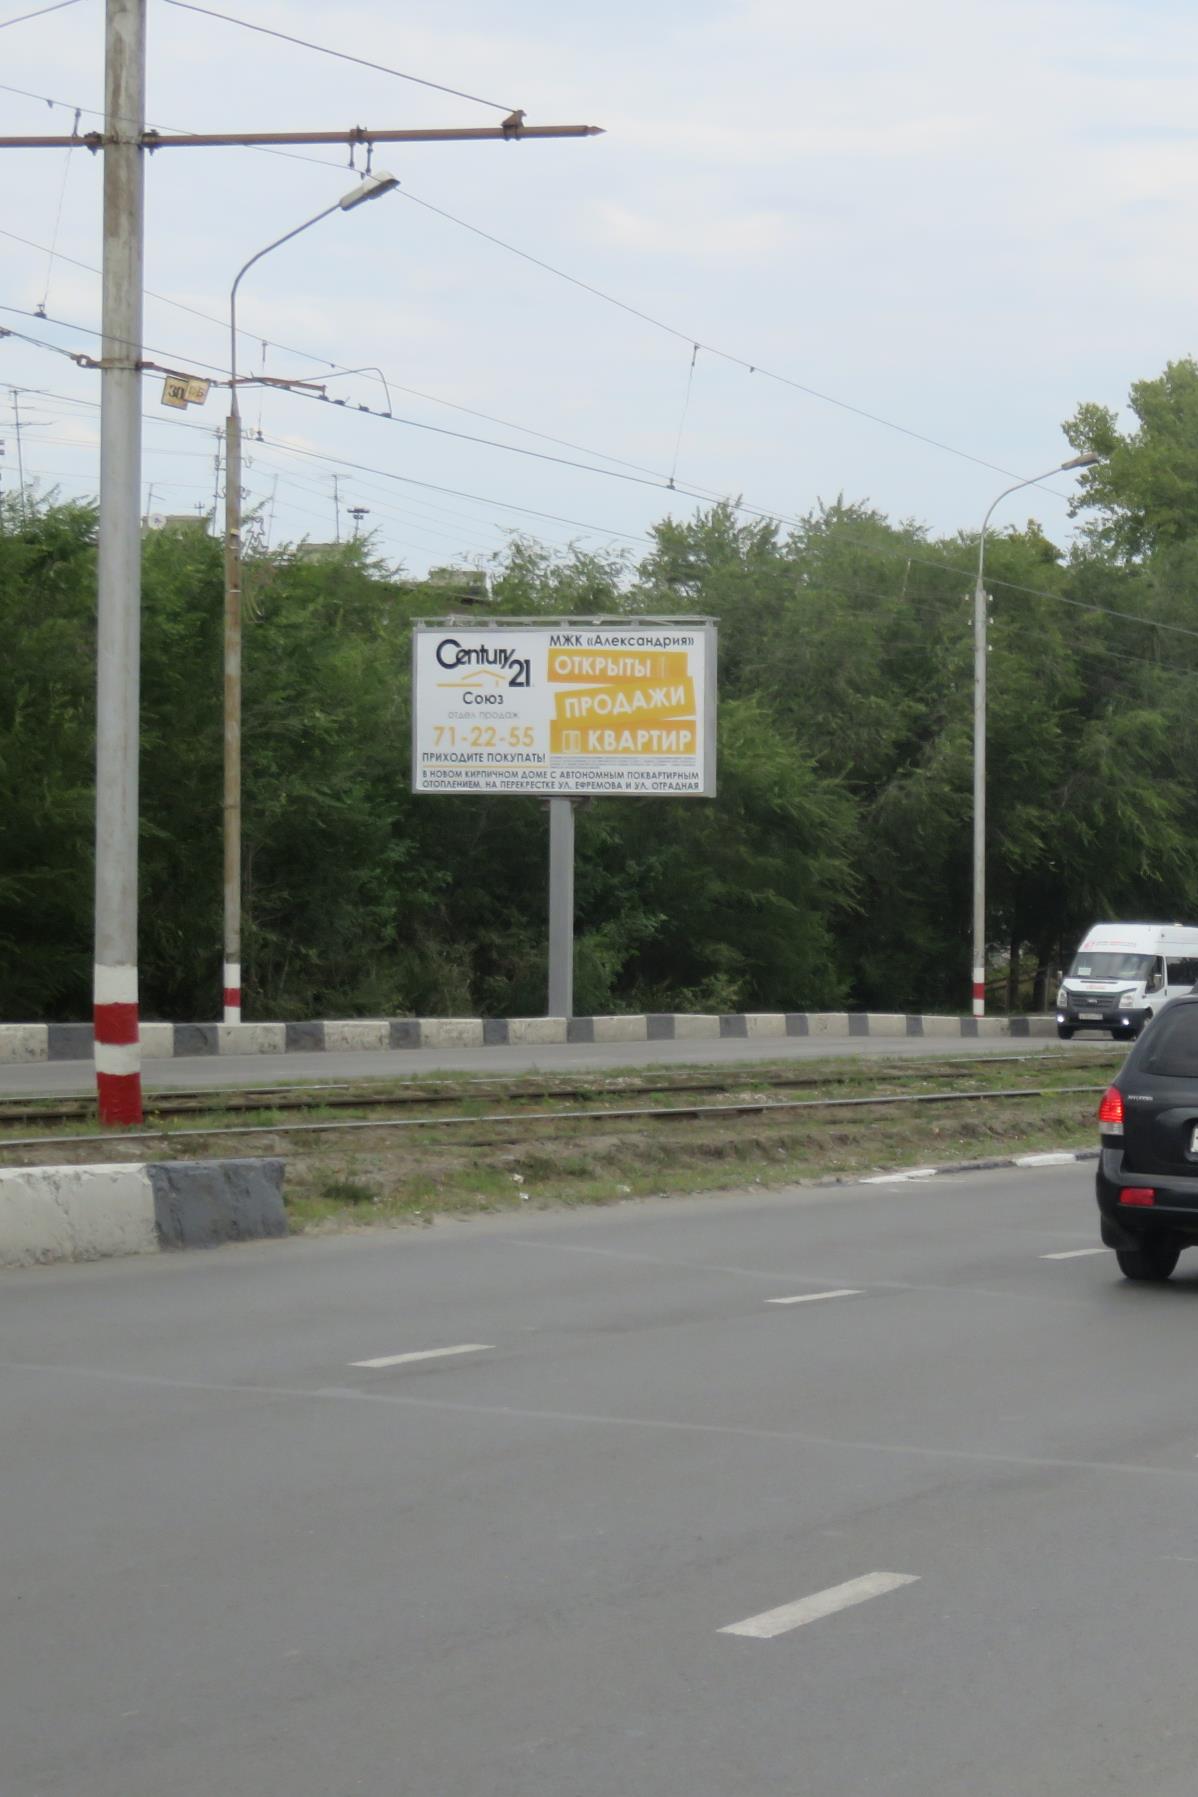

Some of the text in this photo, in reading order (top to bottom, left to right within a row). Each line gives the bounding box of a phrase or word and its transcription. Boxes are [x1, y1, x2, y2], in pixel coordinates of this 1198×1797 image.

[549, 634, 694, 649] МЖК «Александрия»
[436, 638, 516, 670] Century
[508, 659, 531, 688] 21
[554, 655, 652, 678] ОТКРЫТЫ
[462, 691, 504, 705] Союз
[564, 684, 685, 719] ПРОДАЖИ
[480, 711, 519, 720] продаж
[432, 725, 535, 748] 71-22-55
[587, 729, 692, 752] КВАРТИР
[422, 753, 483, 763] ПРИХОДИТЕ
[487, 753, 546, 763] ПОКУПАТЬ!
[422, 770, 428, 778] В
[430, 770, 463, 779] НОВОМ
[465, 771, 519, 779] КИРПИЧНОМ
[521, 771, 548, 780] ДОМЕ
[559, 771, 625, 780] АВТОНОМНЫМ
[627, 772, 699, 780] ПОКВАРТИРНЫМ
[485, 781, 498, 789] НА
[500, 781, 555, 789] ПЕРЕКРЕСТКЕ
[575, 782, 622, 790] ЕФРЕМОВА
[625, 782, 632, 790] И
[651, 782, 699, 790] ОТРАДНАЯ
